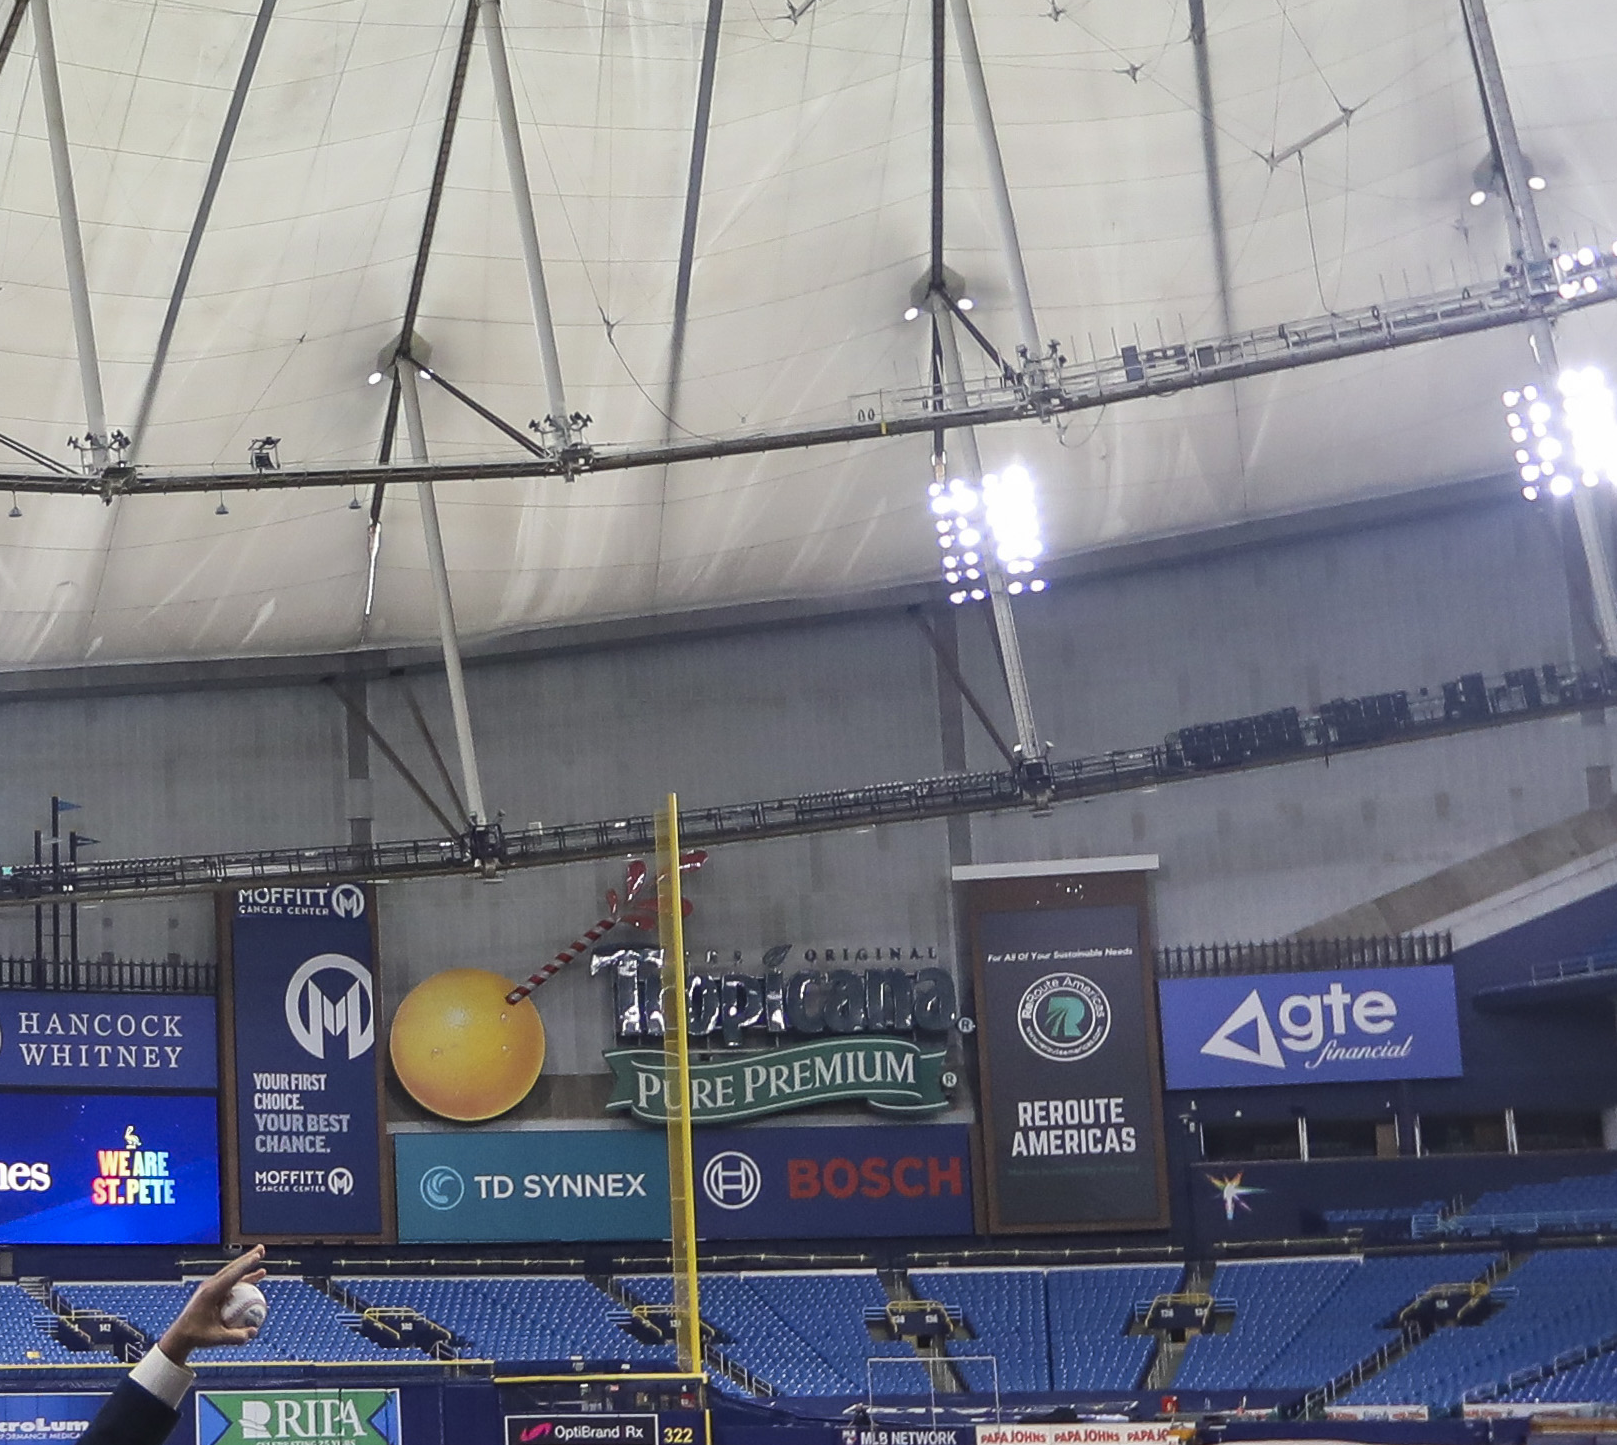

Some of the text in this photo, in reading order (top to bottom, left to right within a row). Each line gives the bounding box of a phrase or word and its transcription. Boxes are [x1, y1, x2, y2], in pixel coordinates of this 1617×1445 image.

[238, 887, 328, 906] MOFFITT
[239, 905, 329, 916] CANCER CENTER
[803, 946, 939, 964] ORIGINAL
[19, 1012, 183, 1037] HANCOCK
[1278, 982, 1398, 1052] gte
[19, 1043, 183, 1069] WHITNEY
[1304, 1033, 1414, 1069] financial
[253, 1072, 327, 1091] YOUR FIRST
[637, 1050, 917, 1111] PURE PREMIUM
[254, 1093, 304, 1110] CHOICE.
[1017, 1097, 1125, 1128] REROUTE
[254, 1113, 351, 1133] YOUR BEST
[255, 1134, 331, 1154] CHANCE.
[1011, 1126, 1137, 1158] AMERICAS
[96, 1150, 170, 1178] WE ARE
[255, 1170, 325, 1185] MOFFITT
[474, 1172, 647, 1199] TD SYNNEX
[787, 1156, 963, 1200] BOSCH
[256, 1185, 326, 1193] CANCER CENTER
[554, 1424, 645, 1442] OptiBrand Rx
[664, 1426, 694, 1444] 322
